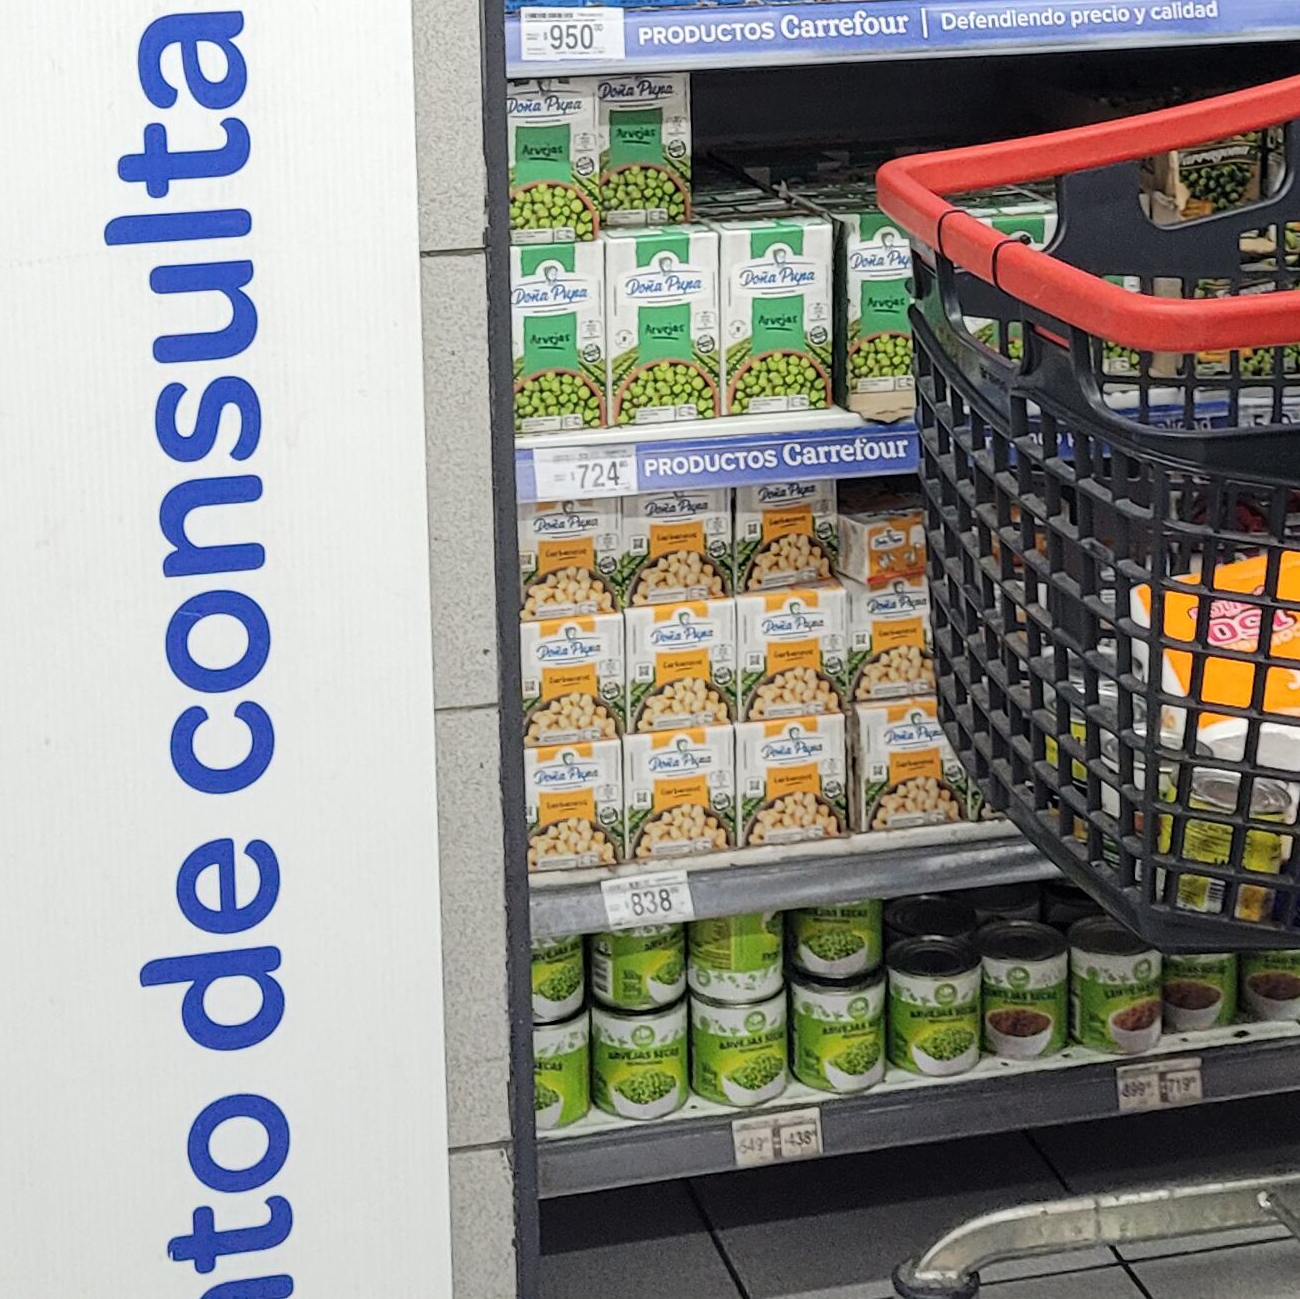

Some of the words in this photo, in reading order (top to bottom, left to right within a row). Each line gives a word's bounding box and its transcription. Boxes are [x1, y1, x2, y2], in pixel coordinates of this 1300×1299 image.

[639, 23, 774, 45] PRODUCTOS
[781, 14, 908, 38] Carrefour
[941, 9, 1066, 30] Defendiendo
[1070, 7, 1130, 29] precio
[1135, 8, 1146, 24] y
[1151, 0, 1218, 21] calidad
[616, 127, 655, 139] Arvejas
[530, 334, 570, 346] Arvejas
[758, 315, 797, 327] Arvejas
[104, 9, 274, 795] consulta
[644, 450, 777, 476] PRODUCTOS
[783, 437, 908, 467] Carrefour
[140, 836, 286, 1051] de
[167, 1092, 295, 1299] to
